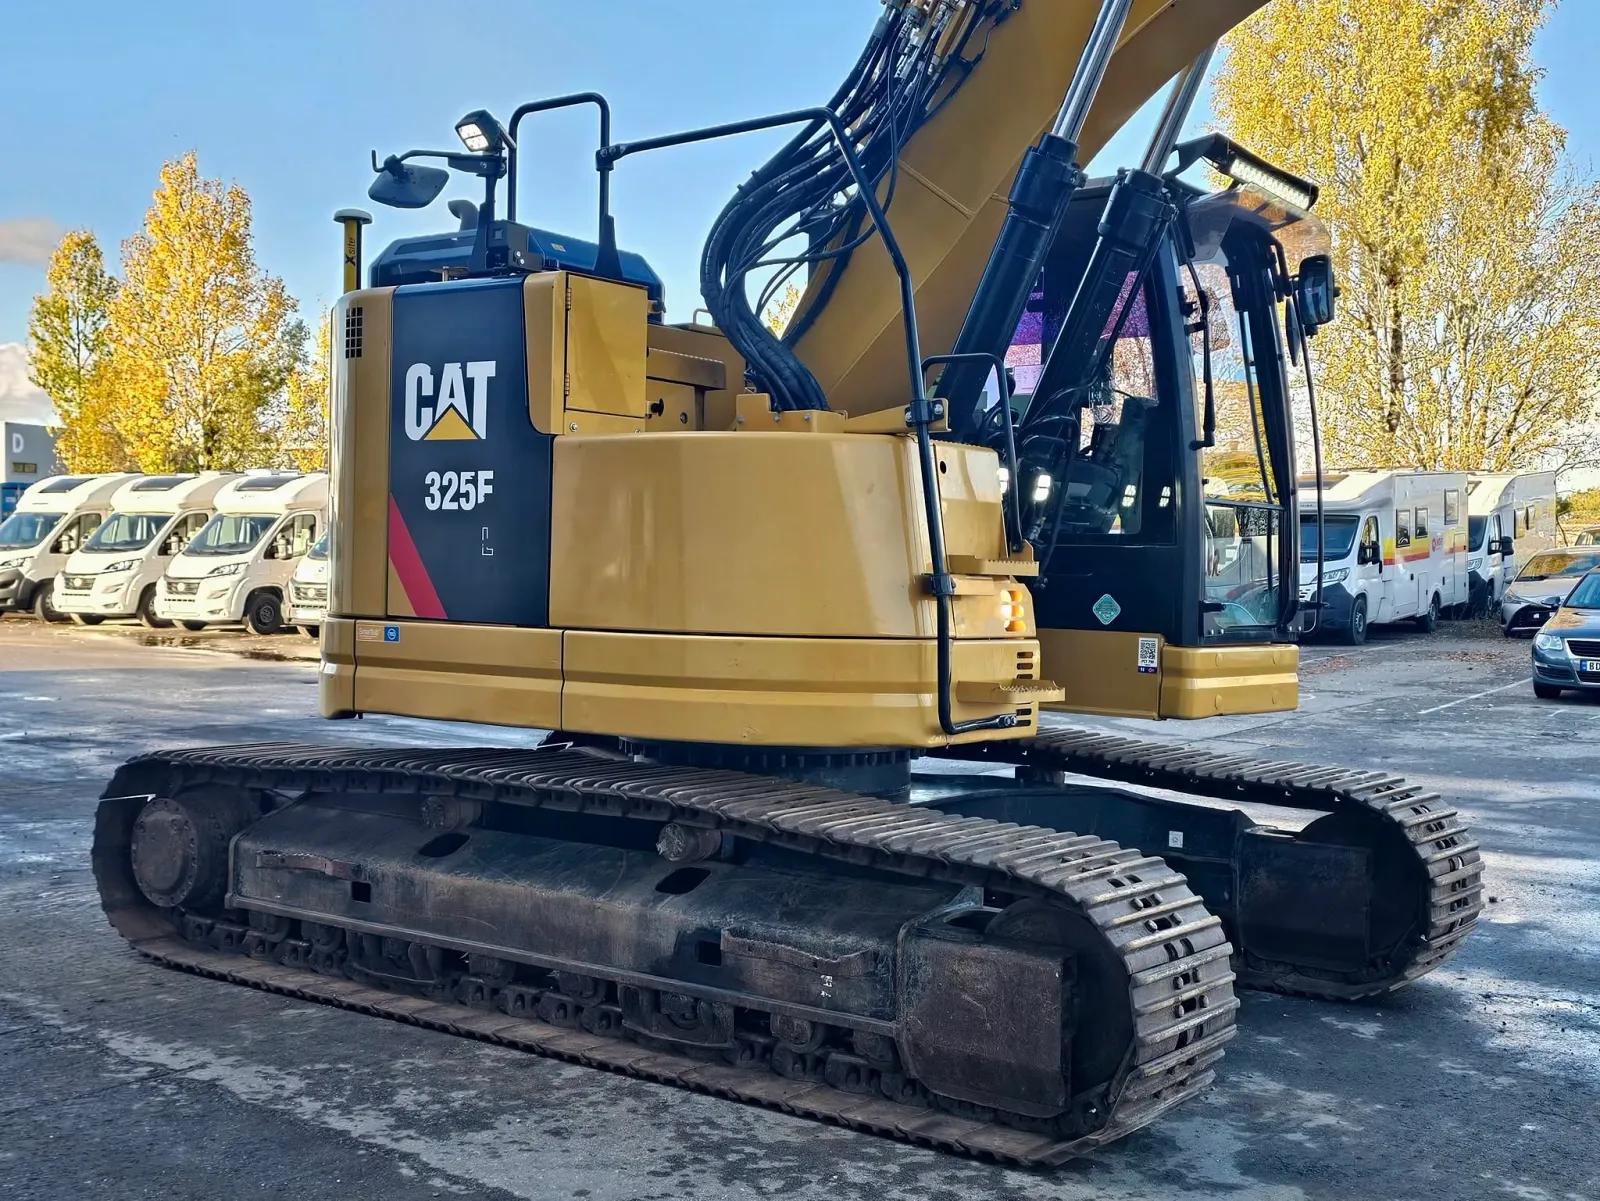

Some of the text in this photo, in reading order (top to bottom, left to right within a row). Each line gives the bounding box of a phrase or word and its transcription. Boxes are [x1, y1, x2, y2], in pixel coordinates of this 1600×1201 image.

[405, 361, 496, 441] CAT
[12, 432, 24, 453] D
[424, 470, 494, 511] 325F
